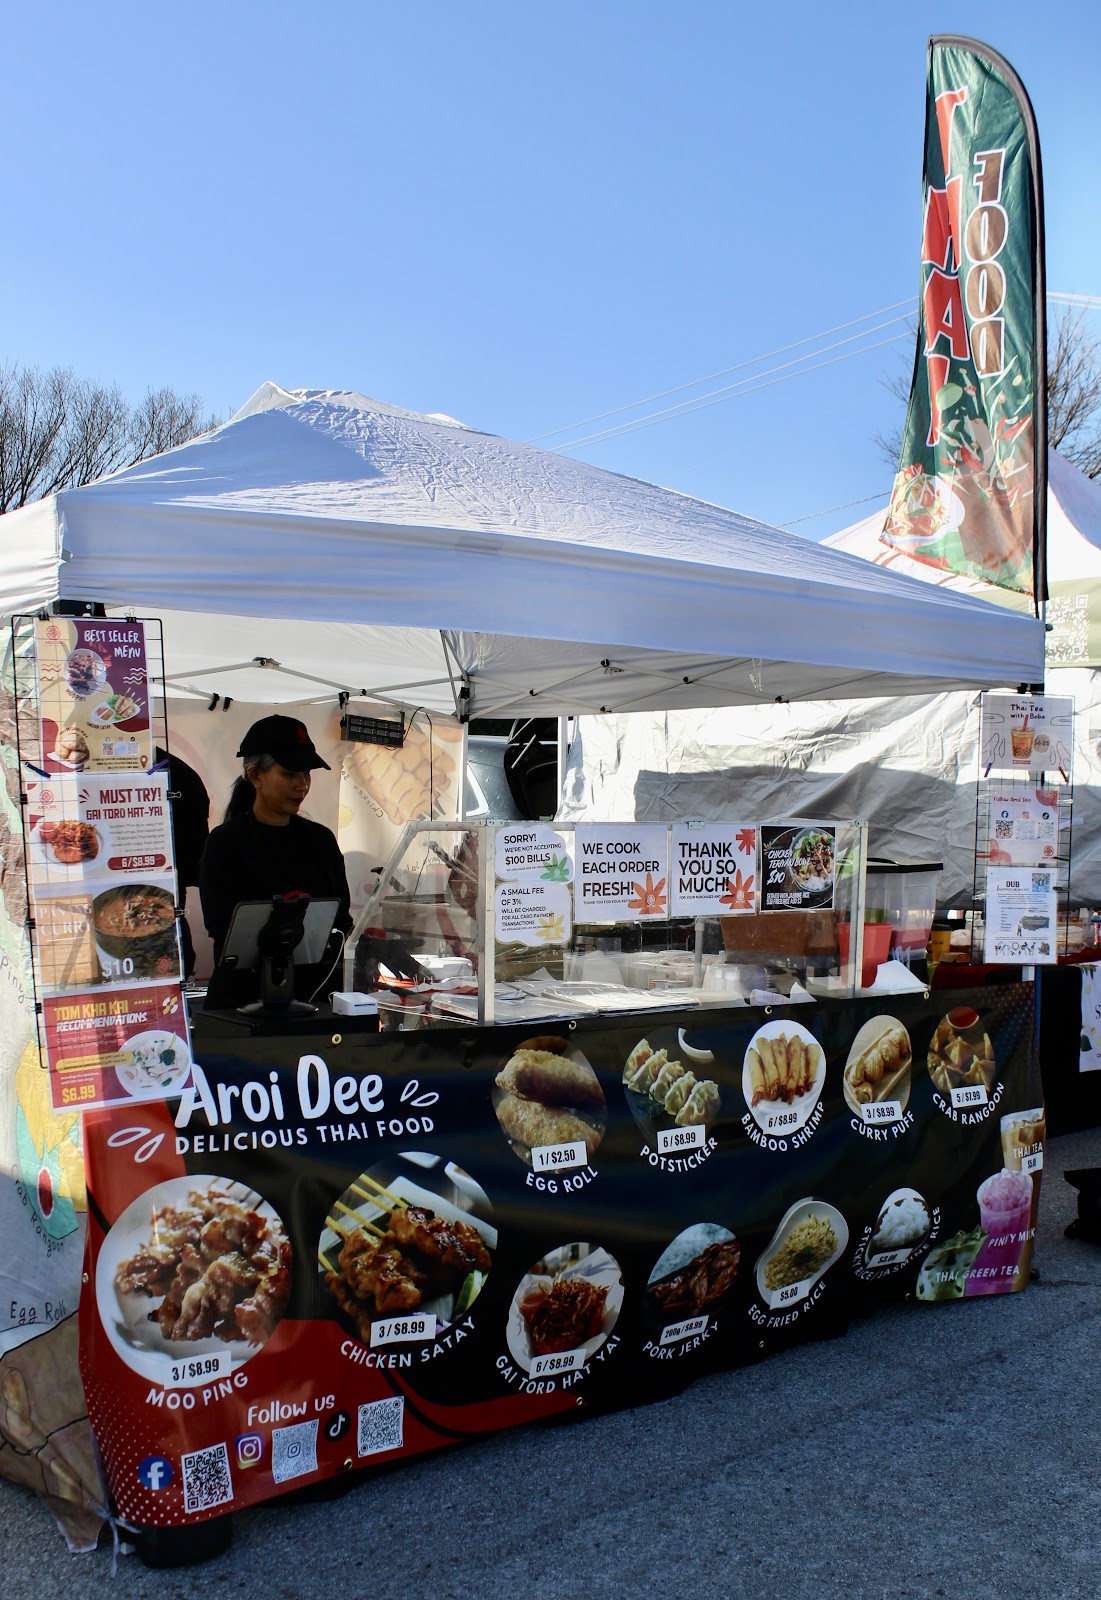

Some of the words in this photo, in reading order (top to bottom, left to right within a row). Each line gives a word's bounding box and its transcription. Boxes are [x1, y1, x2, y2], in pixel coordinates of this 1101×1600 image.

[84, 630, 106, 642] BEST
[108, 630, 140, 643] SELLER
[114, 646, 141, 658] MENU
[1029, 704, 1044, 712] Tea
[100, 789, 133, 804] MUST
[135, 788, 162, 802] TRY!
[86, 809, 101, 820] GAI
[128, 806, 163, 818] HAT-YAI
[504, 834, 537, 844] SORRY!
[534, 843, 562, 852] ACCEPTING
[582, 843, 604, 854] WE
[606, 842, 641, 854] COOK
[505, 855, 525, 866] $100
[528, 852, 550, 863] BILLS
[678, 842, 732, 858] THANK
[582, 862, 616, 874] EACH
[618, 860, 660, 873] ORDER
[678, 860, 712, 876] YOU
[716, 860, 736, 874] SO
[679, 877, 730, 893] MUCH!
[766, 868, 786, 885] $10
[1006, 880, 1020, 888] DUB
[508, 888, 530, 896] SMALL
[583, 882, 634, 897] FRESH!
[512, 898, 522, 906] 3%
[41, 918, 92, 936] CURRY
[102, 958, 134, 978] $10
[54, 1006, 80, 1021] TOM
[83, 1003, 108, 1018] KHA
[110, 1000, 128, 1015] KAI
[56, 1012, 148, 1032] RECOMMENDATIONS
[62, 1084, 96, 1103] $6.99
[174, 1064, 284, 1128] Aroi
[297, 1055, 385, 1119] Dee
[932, 1093, 958, 1122] CRAB
[962, 1082, 1005, 1124] RANGOON
[740, 1112, 788, 1152] BAMBOO
[792, 1101, 824, 1148] SHRIMP
[850, 1118, 888, 1141] CURRY
[892, 1110, 916, 1138] PUFF
[176, 1128, 308, 1155] DELICIOUS
[317, 1122, 368, 1144] THAI
[376, 1116, 434, 1137] FOOD
[640, 1136, 718, 1173] POTSTICKER
[1013, 1147, 1030, 1159] THAI
[1032, 1142, 1043, 1152] TEA
[526, 1172, 558, 1194] EGG
[563, 1165, 598, 1193] ROLL
[11, 1164, 28, 1206] Crab
[31, 1212, 64, 1258] Rangoon
[930, 1206, 940, 1239] RICE
[936, 1271, 958, 1282] THAI
[962, 1267, 998, 1279] GREEN
[1000, 1264, 1020, 1276] TEA
[780, 1286, 798, 1302] $5.00
[10, 1300, 38, 1324] Egg
[45, 1300, 66, 1321] Roll
[748, 1304, 766, 1324] EGG
[766, 1310, 798, 1328] FRIED
[803, 1280, 826, 1312] RICE
[340, 1340, 412, 1368] CHICKEN
[420, 1316, 475, 1362] SATAY
[642, 1340, 676, 1360] PORK
[678, 1320, 718, 1356] JERKY
[495, 1355, 518, 1383] GAI
[518, 1377, 556, 1394] TORD
[562, 1362, 592, 1389] HAT
[596, 1334, 620, 1362] YAI
[146, 1388, 196, 1410] MOO
[202, 1372, 248, 1406] PING
[248, 1400, 306, 1427] Follow
